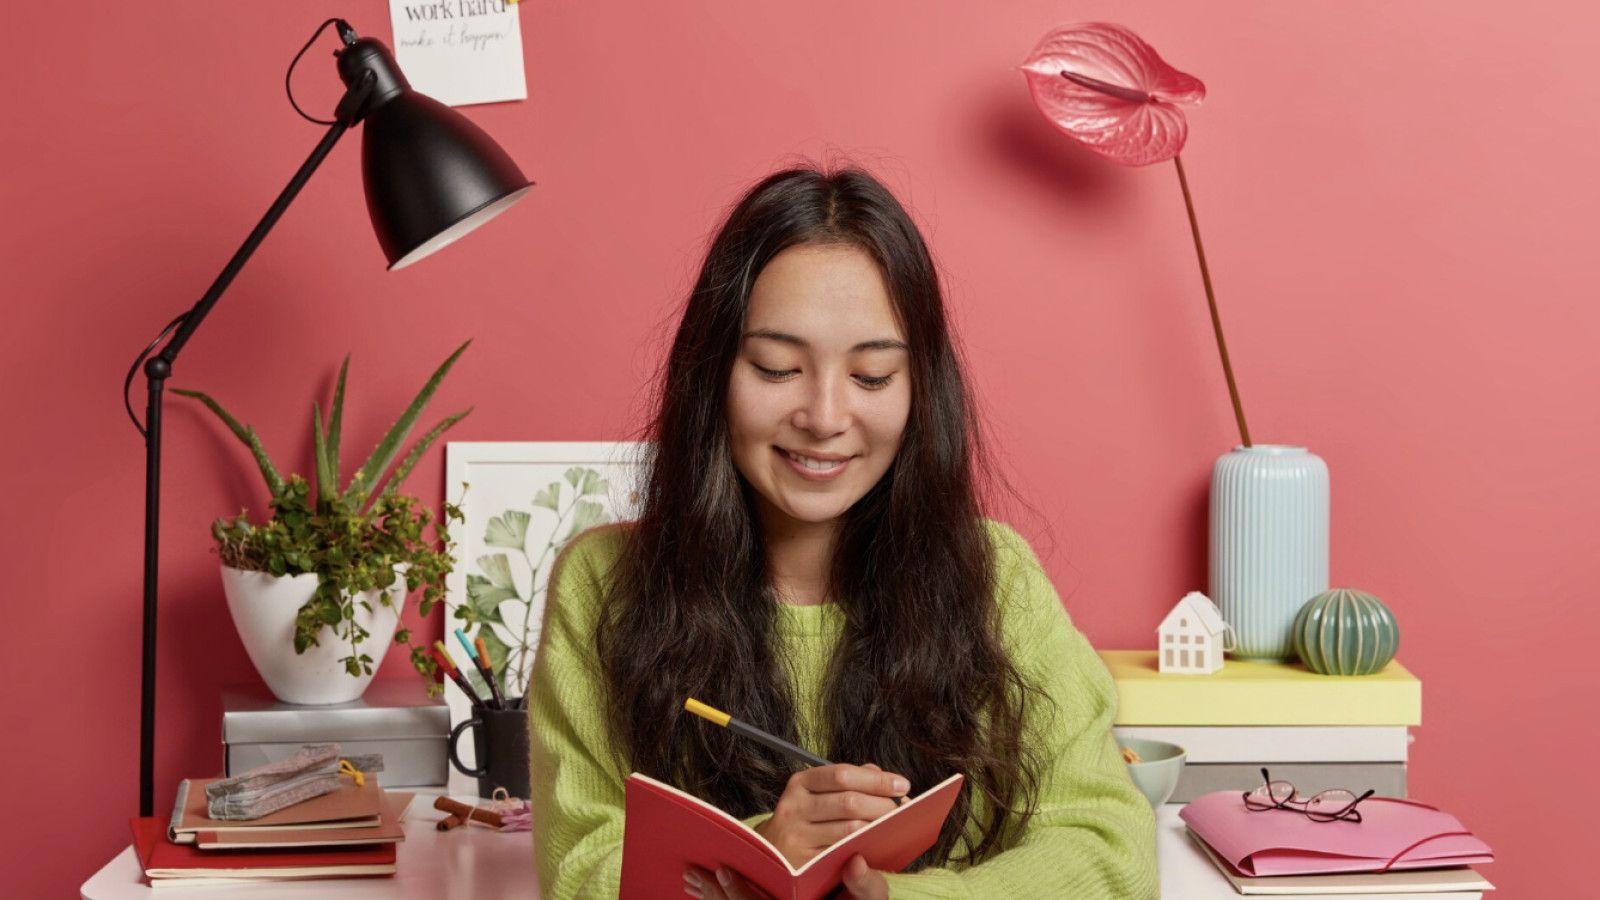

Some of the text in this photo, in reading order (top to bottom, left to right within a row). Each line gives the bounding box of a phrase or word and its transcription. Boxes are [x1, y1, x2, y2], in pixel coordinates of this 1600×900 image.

[405, 0, 454, 22] work
[400, 29, 434, 48] make
[443, 23, 456, 47] it
